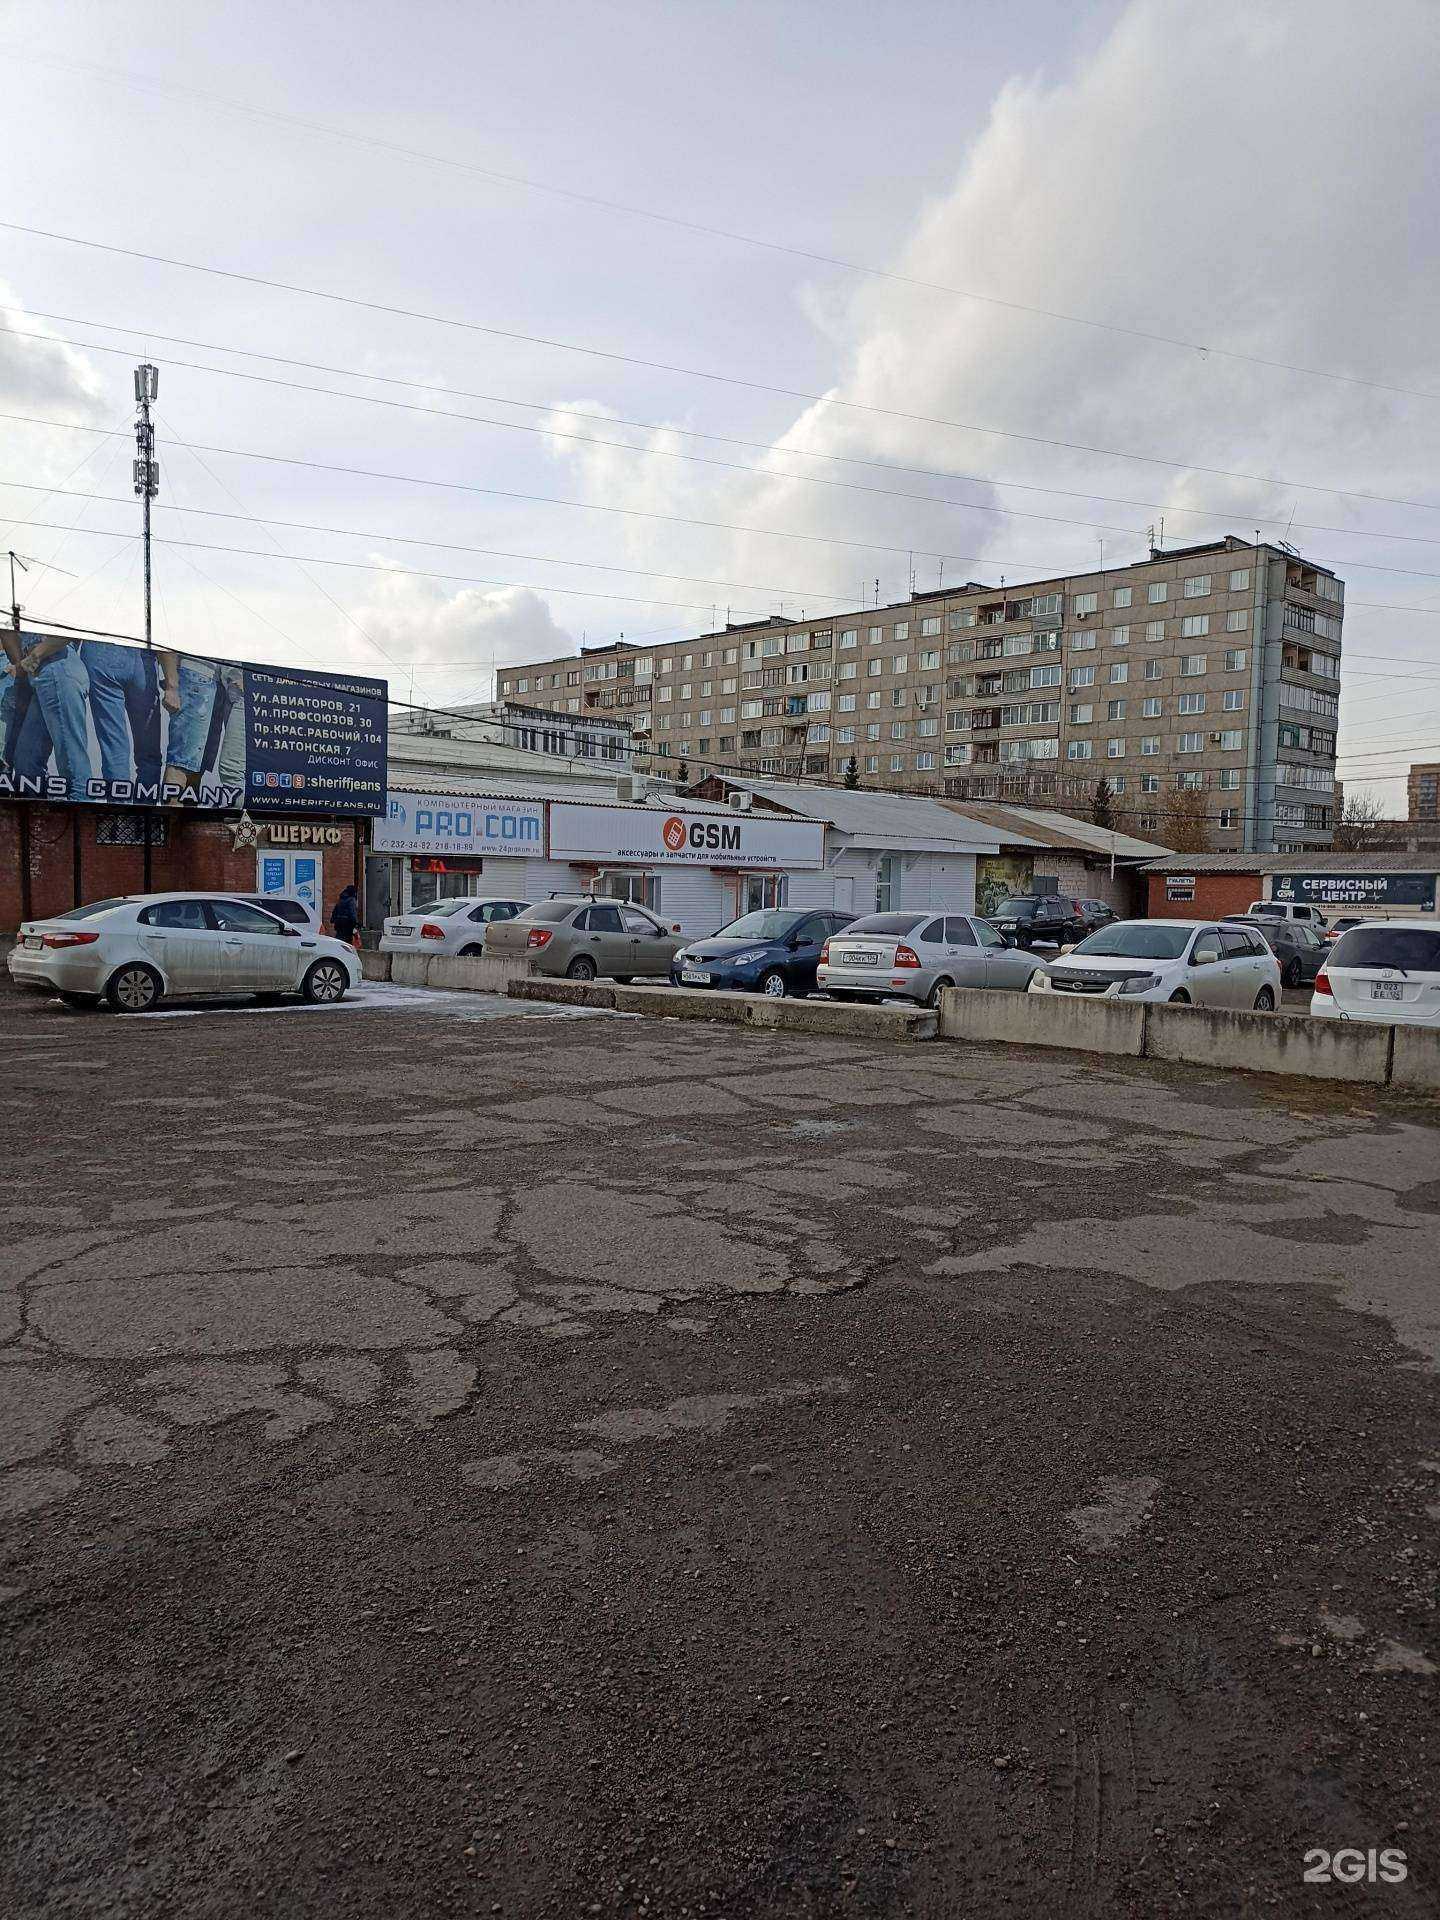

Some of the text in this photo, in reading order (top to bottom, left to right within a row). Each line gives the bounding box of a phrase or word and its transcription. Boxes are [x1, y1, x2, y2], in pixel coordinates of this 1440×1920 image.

[252, 673, 273, 683] СЕТЬ
[335, 684, 382, 696] МАГАЗИНОВ
[348, 703, 360, 713] 21
[359, 718, 372, 728] 30
[345, 746, 351, 755] 7
[307, 754, 379, 769] ДИСКОНТ ОФИС
[87, 778, 241, 804] COMPANY
[252, 796, 380, 810] WWW.SHERIFFJEANS.RU
[417, 799, 538, 814] КОМПЬЮТЕРНЫЙ МАГАЗИН
[271, 825, 342, 844] ШЕРИФ
[689, 822, 741, 850] GSM
[617, 849, 659, 859] аксессуары
[666, 851, 696, 860] запчасти
[697, 853, 709, 861] для
[710, 852, 746, 862] мобильных
[747, 854, 777, 863] устройств
[1302, 878, 1388, 890] СЕРВИСНЫЙ
[1321, 890, 1367, 902] ЦЕНТР
